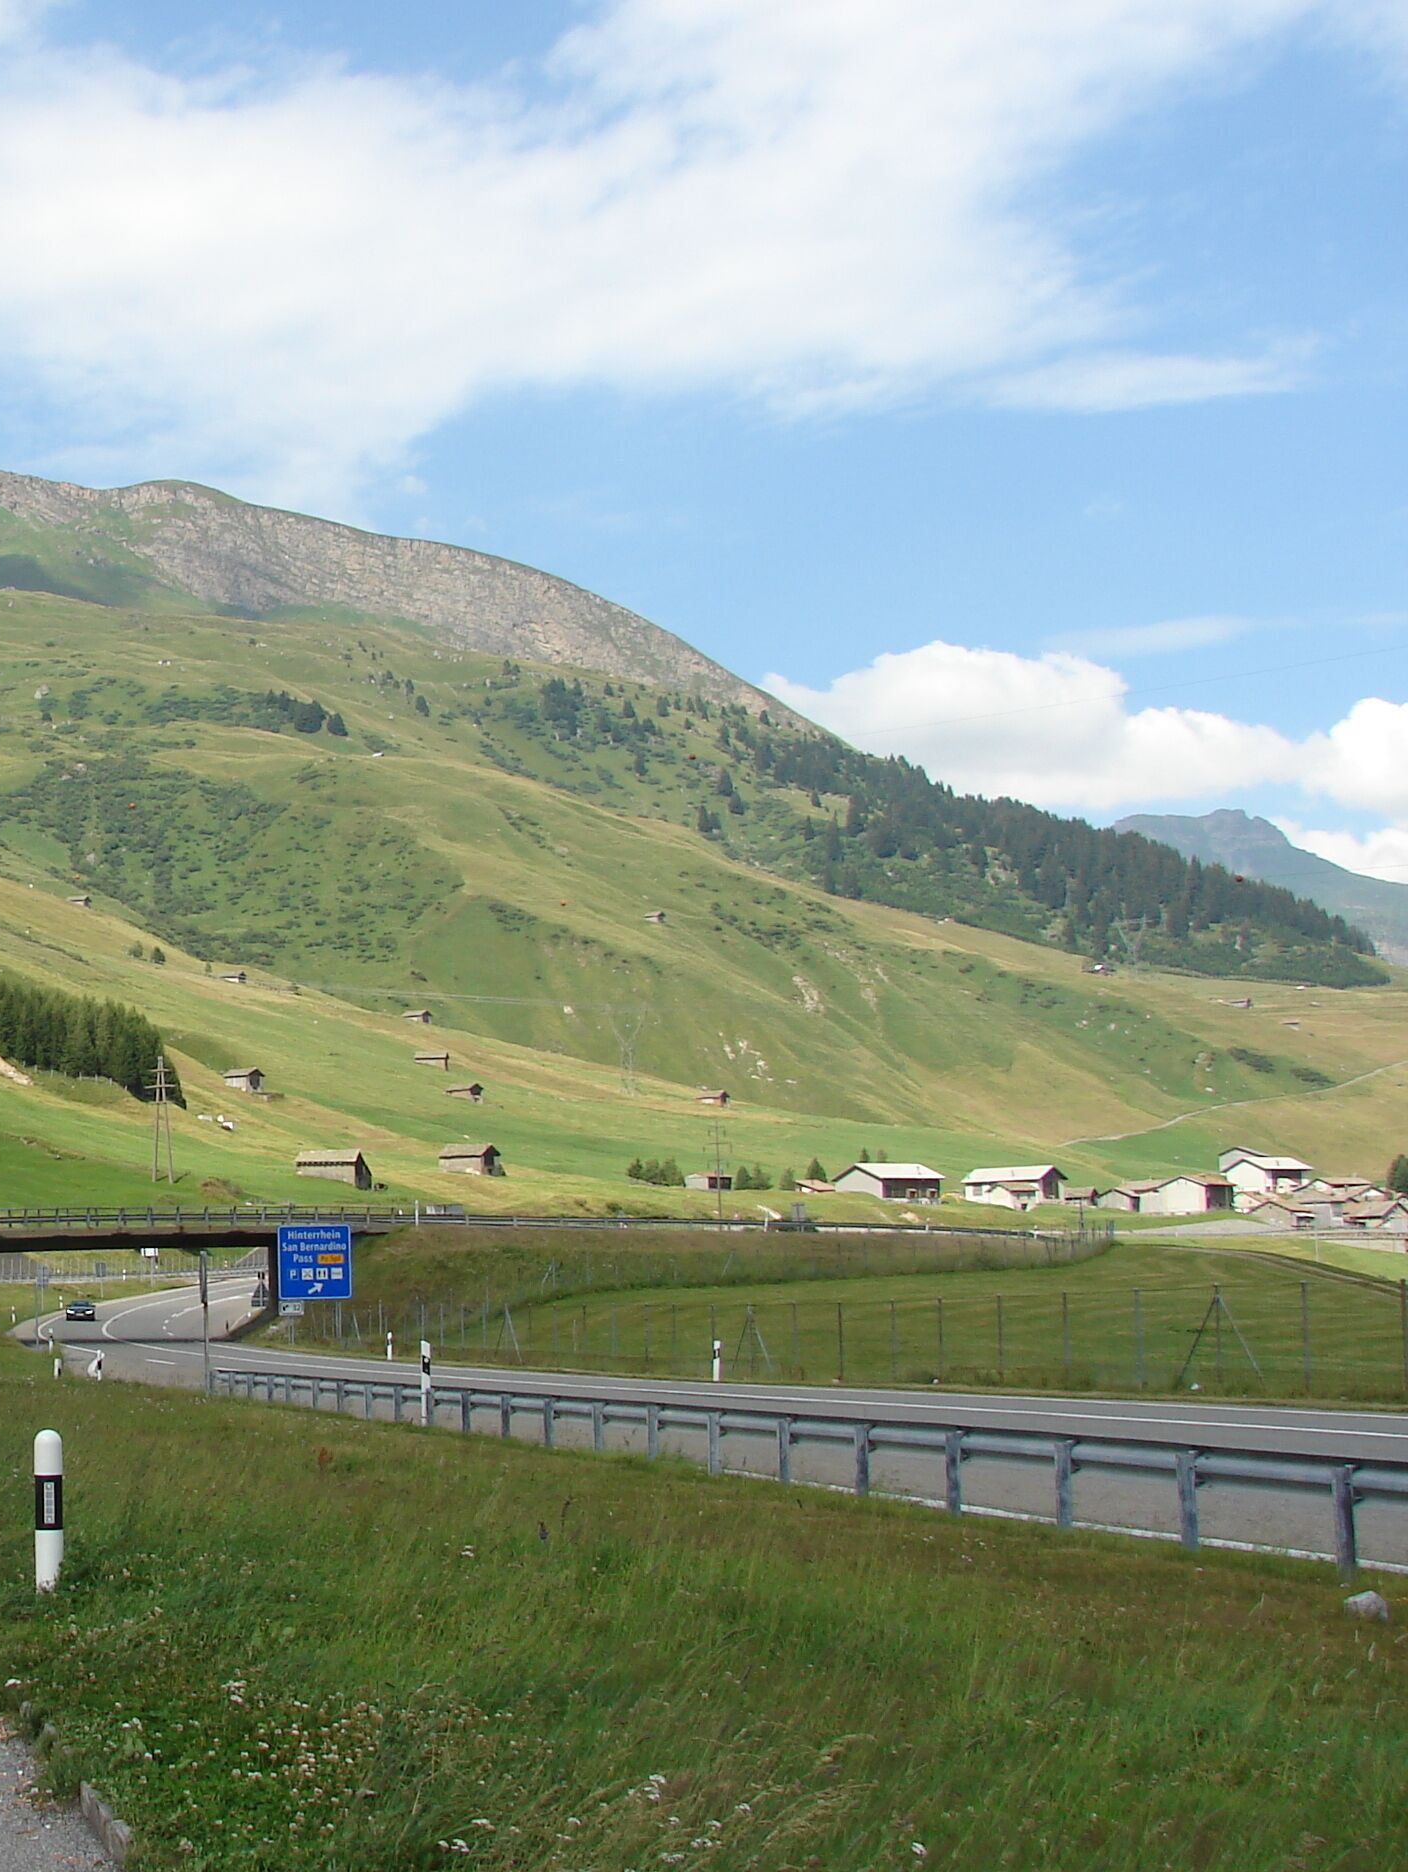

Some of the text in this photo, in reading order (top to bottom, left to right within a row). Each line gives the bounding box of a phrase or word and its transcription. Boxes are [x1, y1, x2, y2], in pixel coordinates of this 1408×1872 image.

[287, 1229, 341, 1240] Hinterrhein
[282, 1241, 347, 1252] San Bernardino
[293, 1253, 313, 1263] Pass
